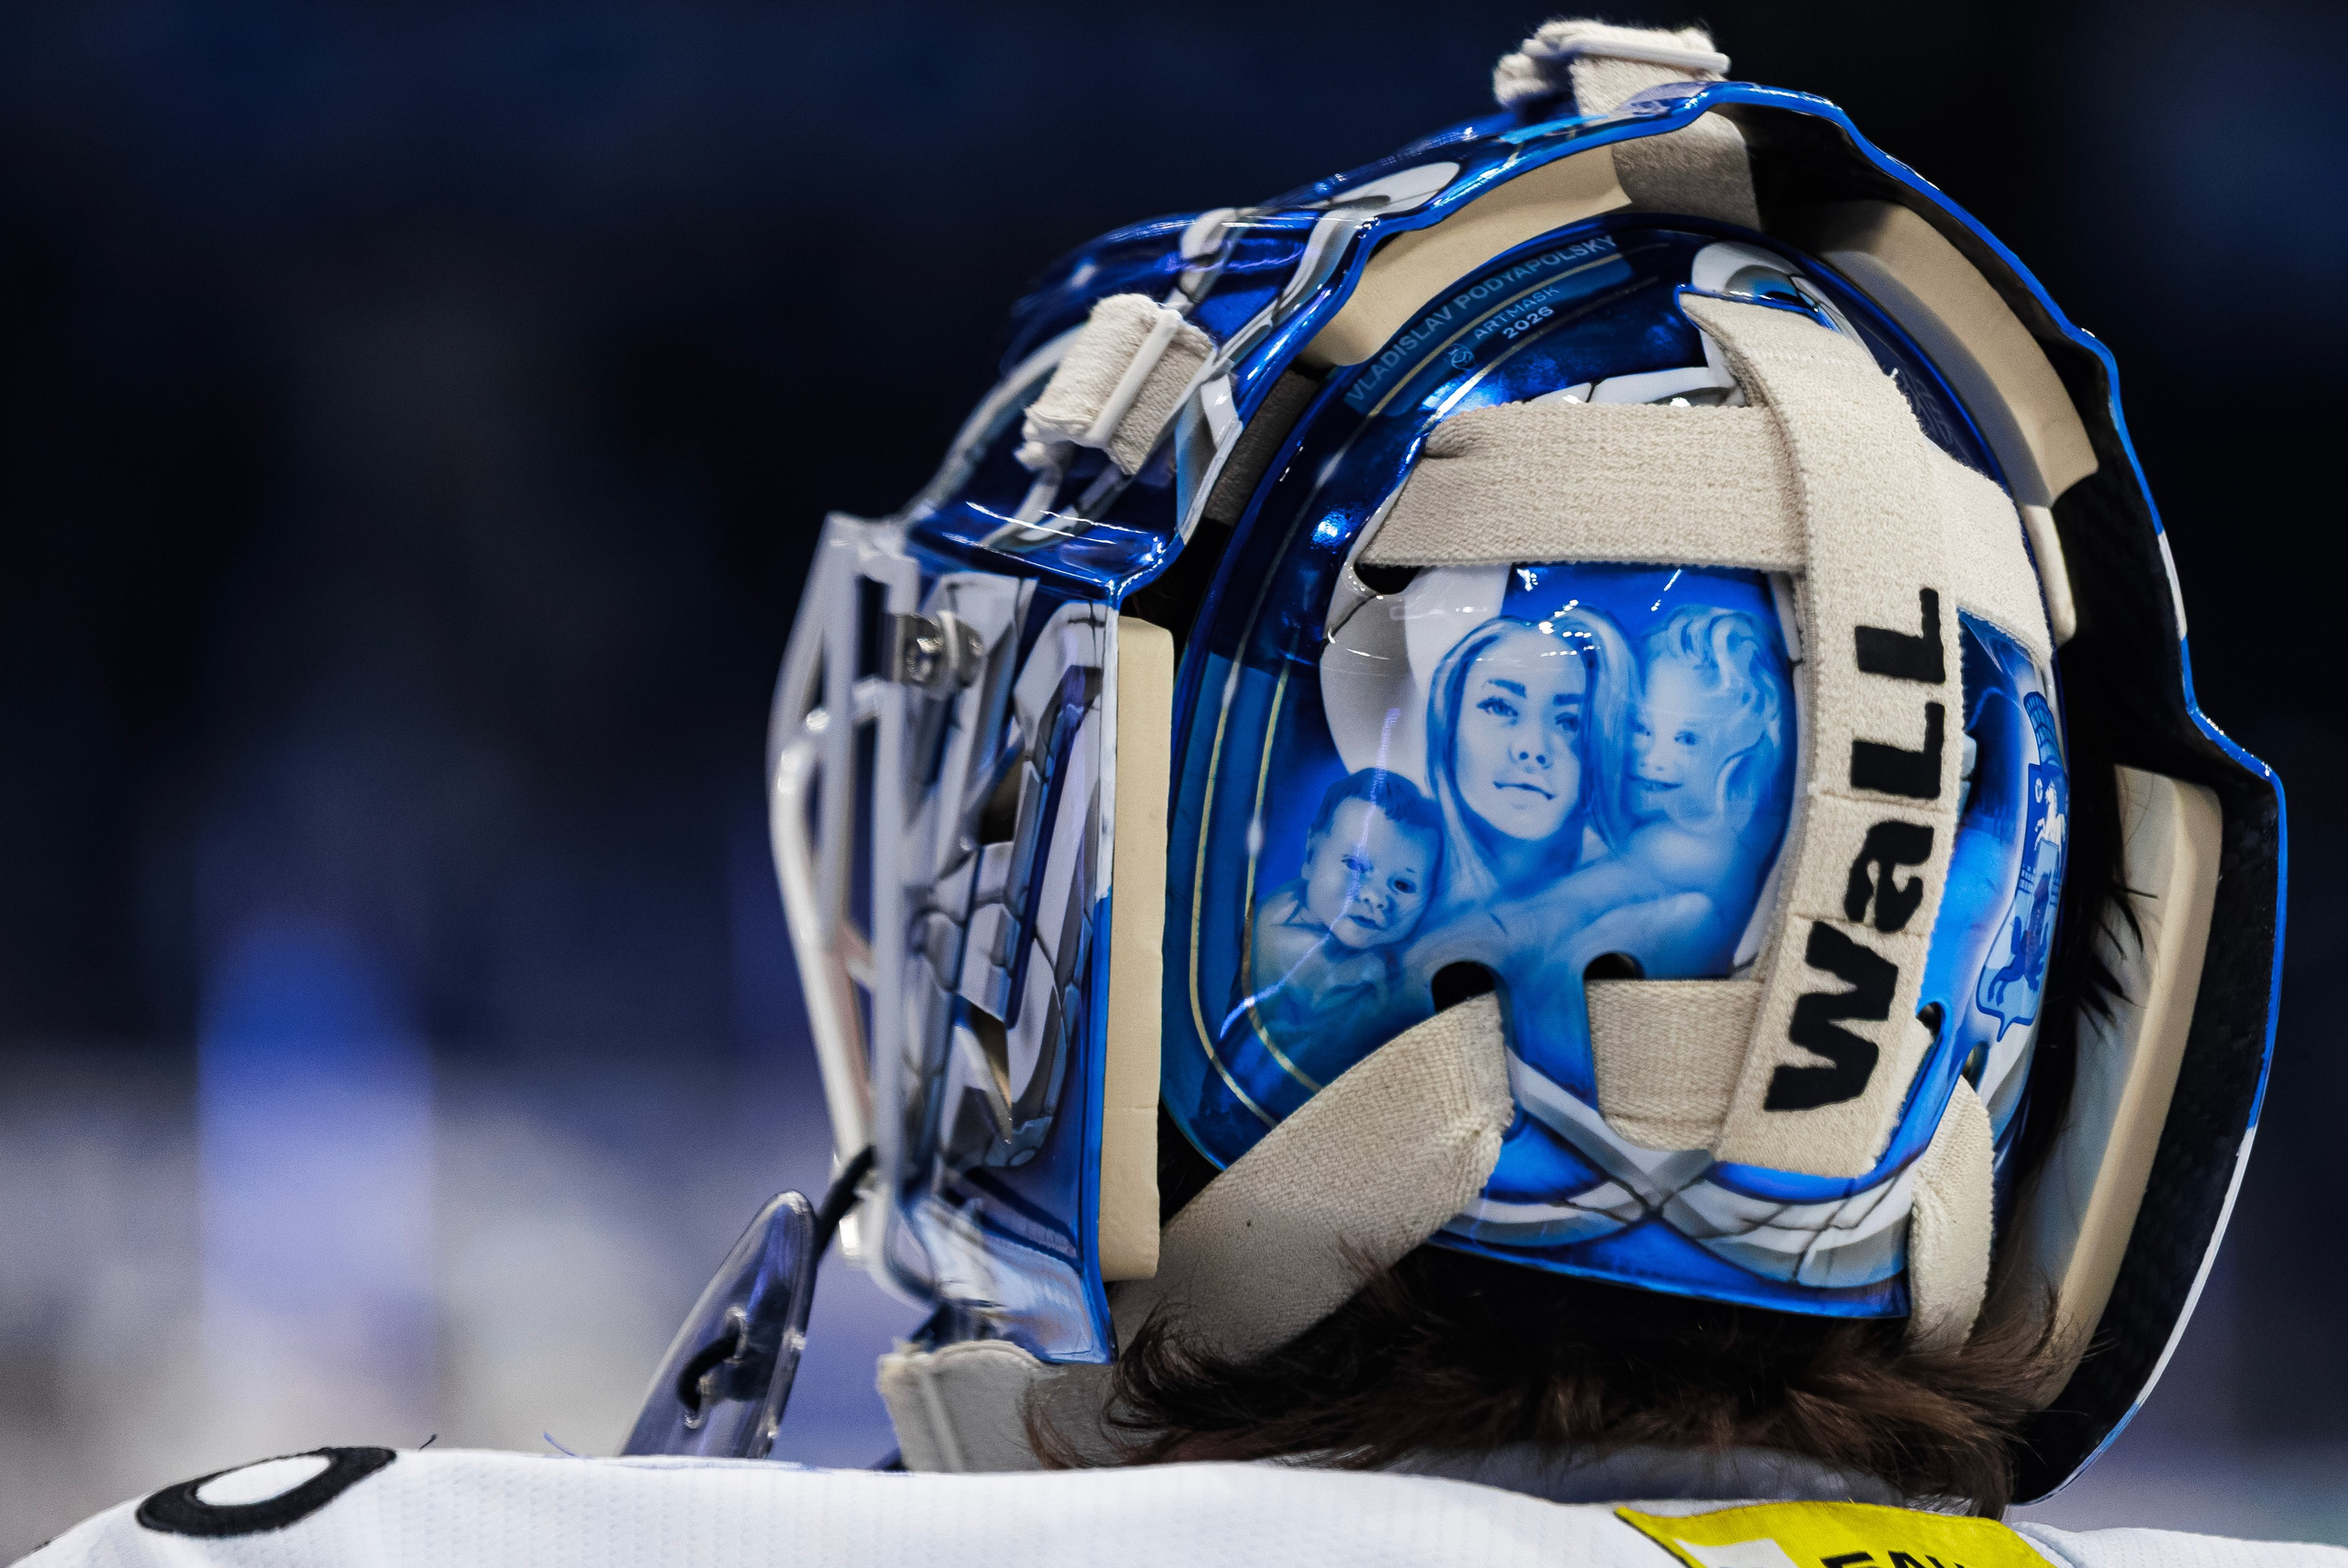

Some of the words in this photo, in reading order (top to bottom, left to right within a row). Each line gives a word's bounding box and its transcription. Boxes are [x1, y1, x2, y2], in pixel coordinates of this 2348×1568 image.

[1346, 305, 1452, 400] VLADISLAV
[1453, 235, 1617, 310] PODYAPOLSKY
[1474, 285, 1559, 339] ARTMASK
[1502, 305, 1554, 339] 2026
